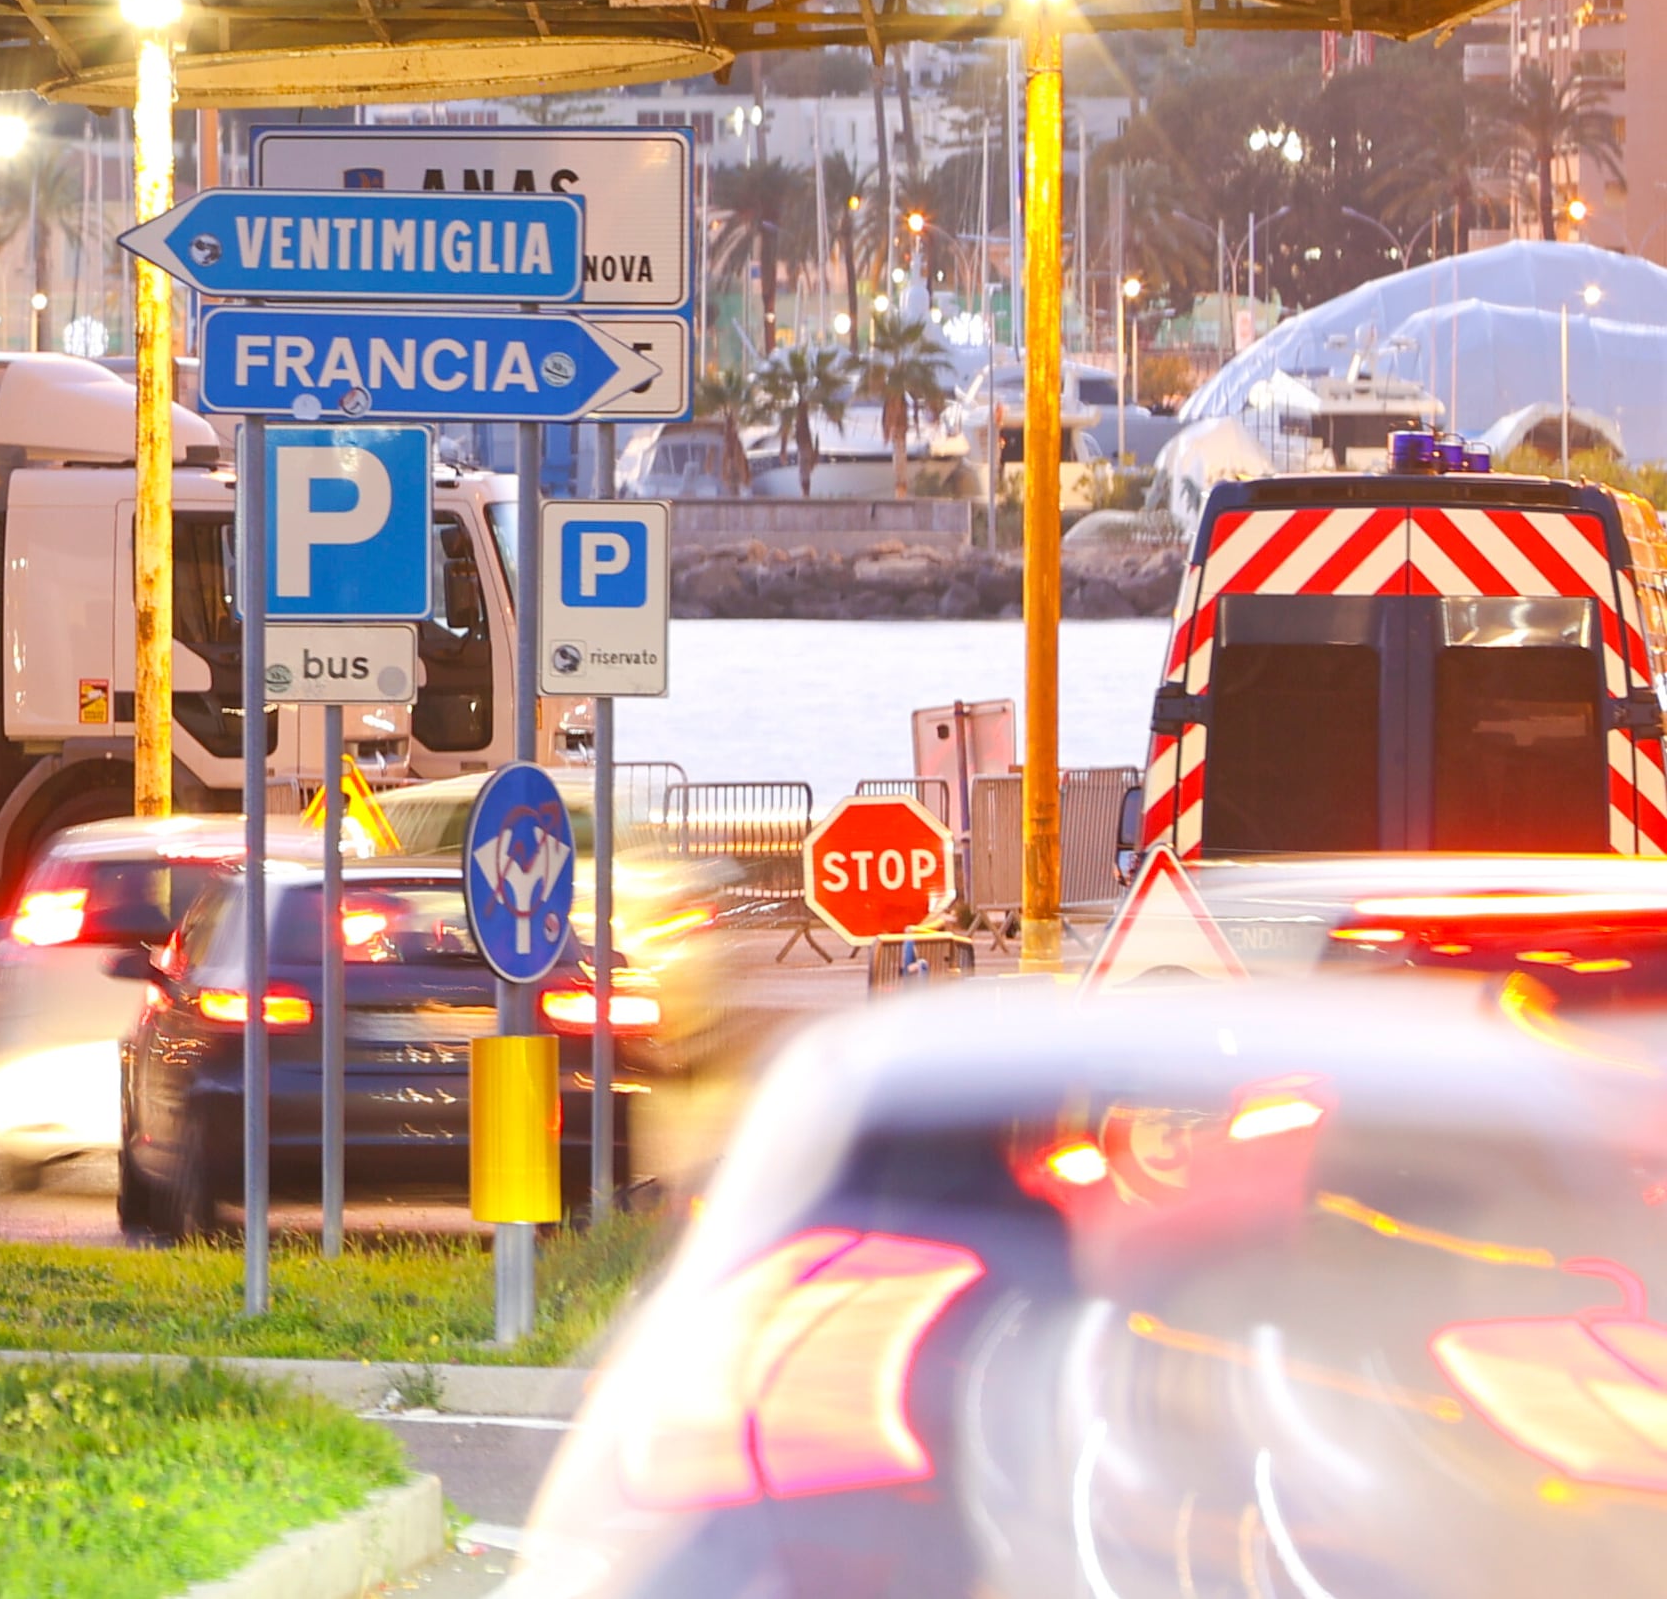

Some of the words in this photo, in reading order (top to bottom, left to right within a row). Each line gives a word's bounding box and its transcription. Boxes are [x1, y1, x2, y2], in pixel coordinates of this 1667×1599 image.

[235, 216, 553, 275] VENTIMIGLIA
[234, 333, 540, 393] FRANCIA
[275, 445, 392, 598] P
[579, 532, 631, 597] P
[302, 649, 370, 681] bus
[589, 648, 659, 668] riservato
[821, 849, 939, 893] STOP
